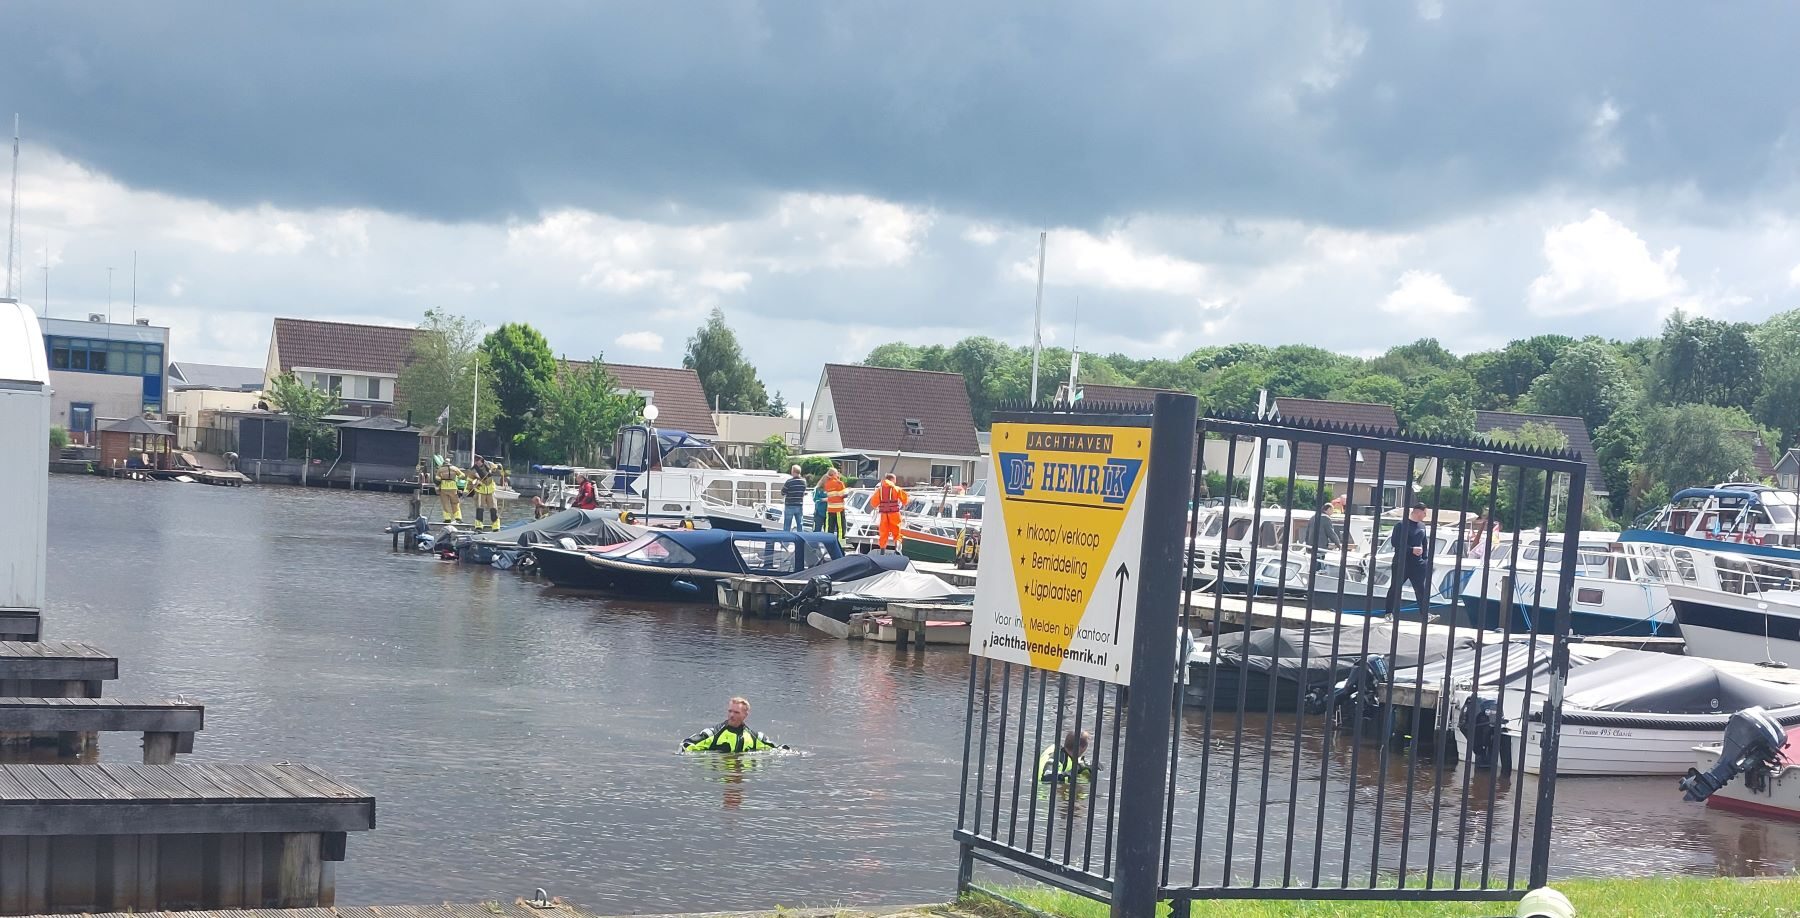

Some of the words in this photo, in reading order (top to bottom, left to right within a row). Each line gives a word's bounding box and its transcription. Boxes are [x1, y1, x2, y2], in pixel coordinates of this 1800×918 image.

[1028, 436, 1112, 450] JACHTHAVEN
[1009, 459, 1035, 490] DE
[1041, 462, 1127, 498] HEMRIK
[1026, 523, 1100, 551] Inkoop/verkoop
[1031, 551, 1088, 579] Bemiddeling
[1030, 578, 1083, 604] Ligplaatsen
[994, 611, 1012, 625] Voor
[1029, 617, 1060, 635] Melden
[1063, 623, 1074, 639] bij
[1076, 625, 1111, 643] kantoor
[989, 631, 1108, 666] jachthavendehemrik.nl
